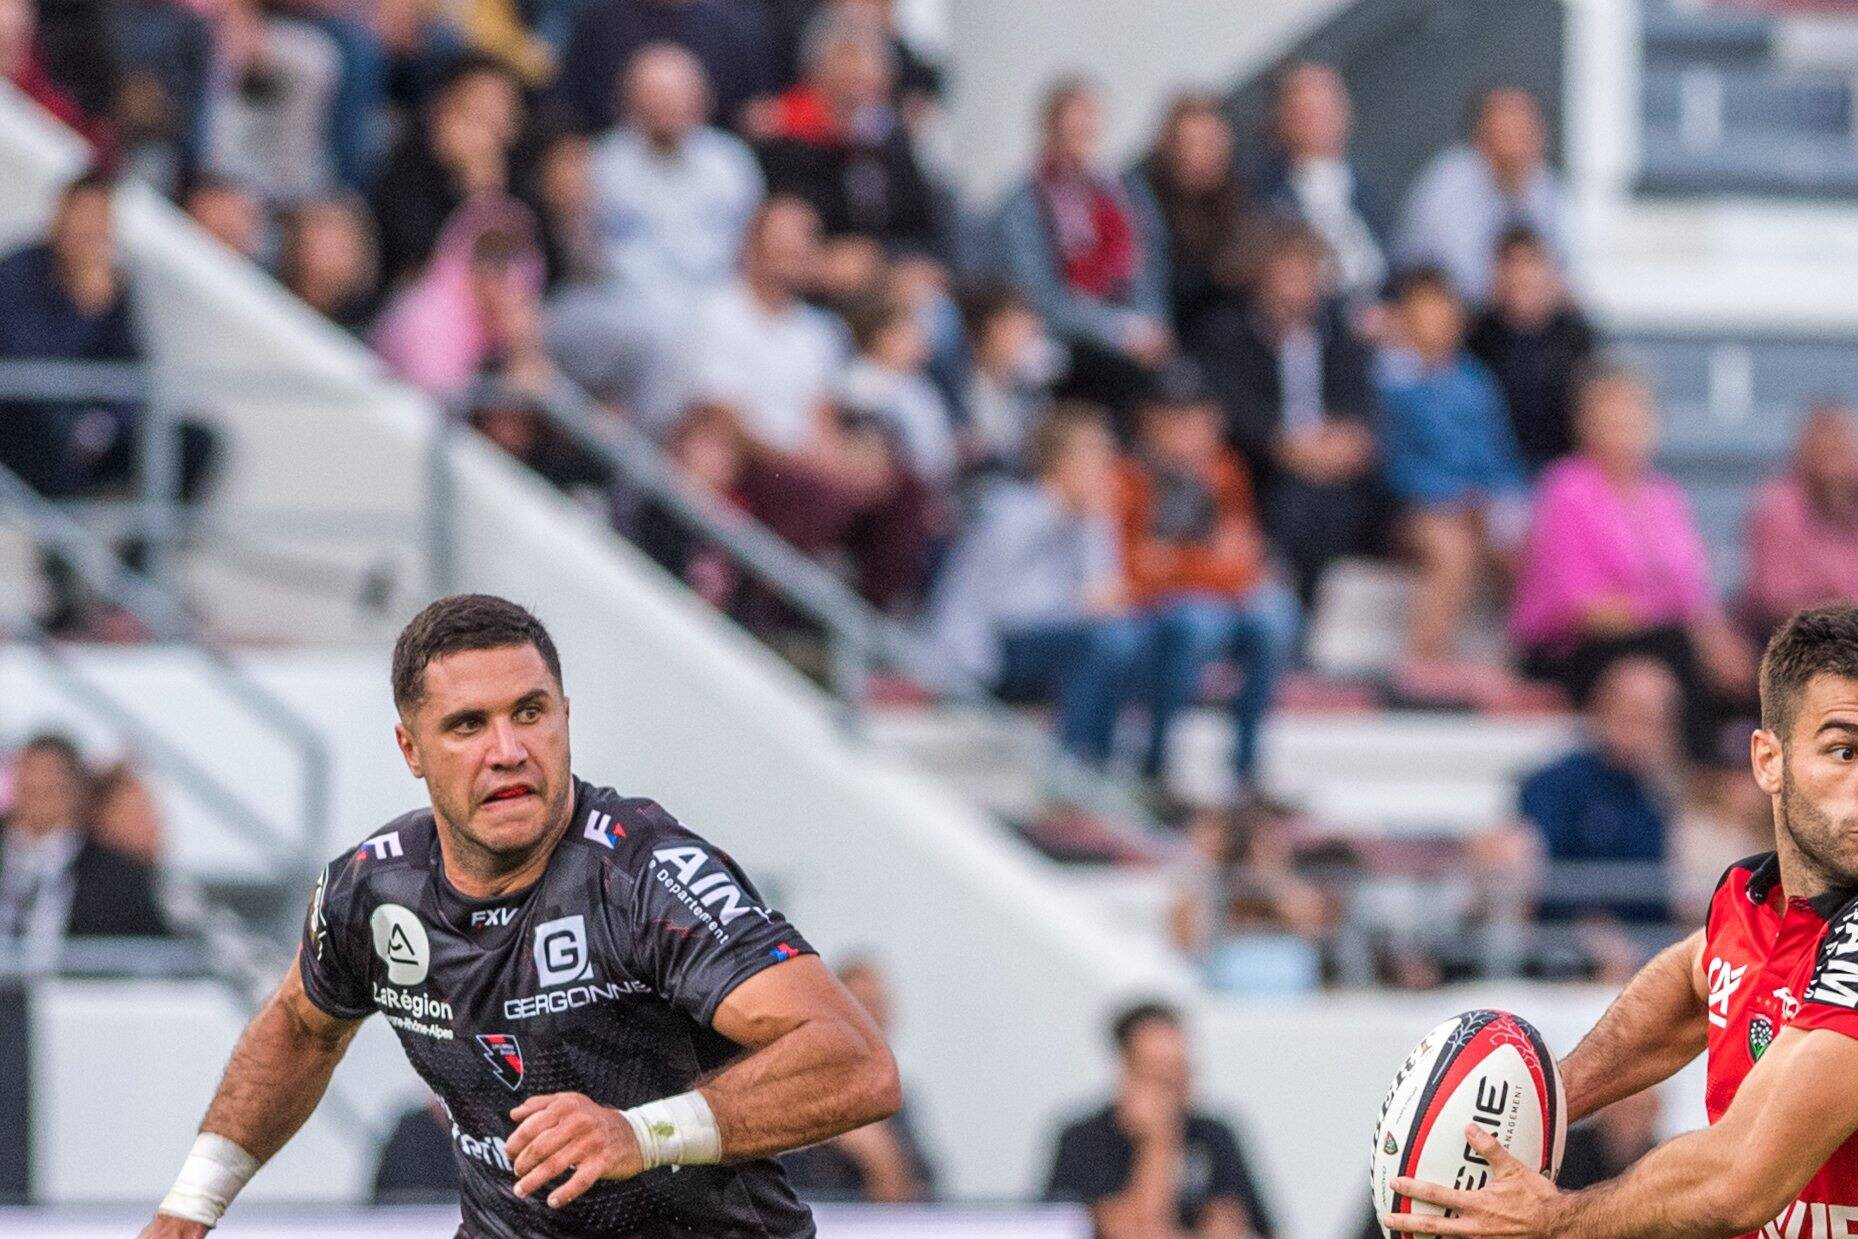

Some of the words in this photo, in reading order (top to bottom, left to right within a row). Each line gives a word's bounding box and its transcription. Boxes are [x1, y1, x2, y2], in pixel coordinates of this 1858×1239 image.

[652, 846, 751, 926] AIN
[471, 907, 519, 927] FXV
[504, 980, 652, 1020] GERGONNE
[1504, 1084, 1523, 1150] ANAGEMENT
